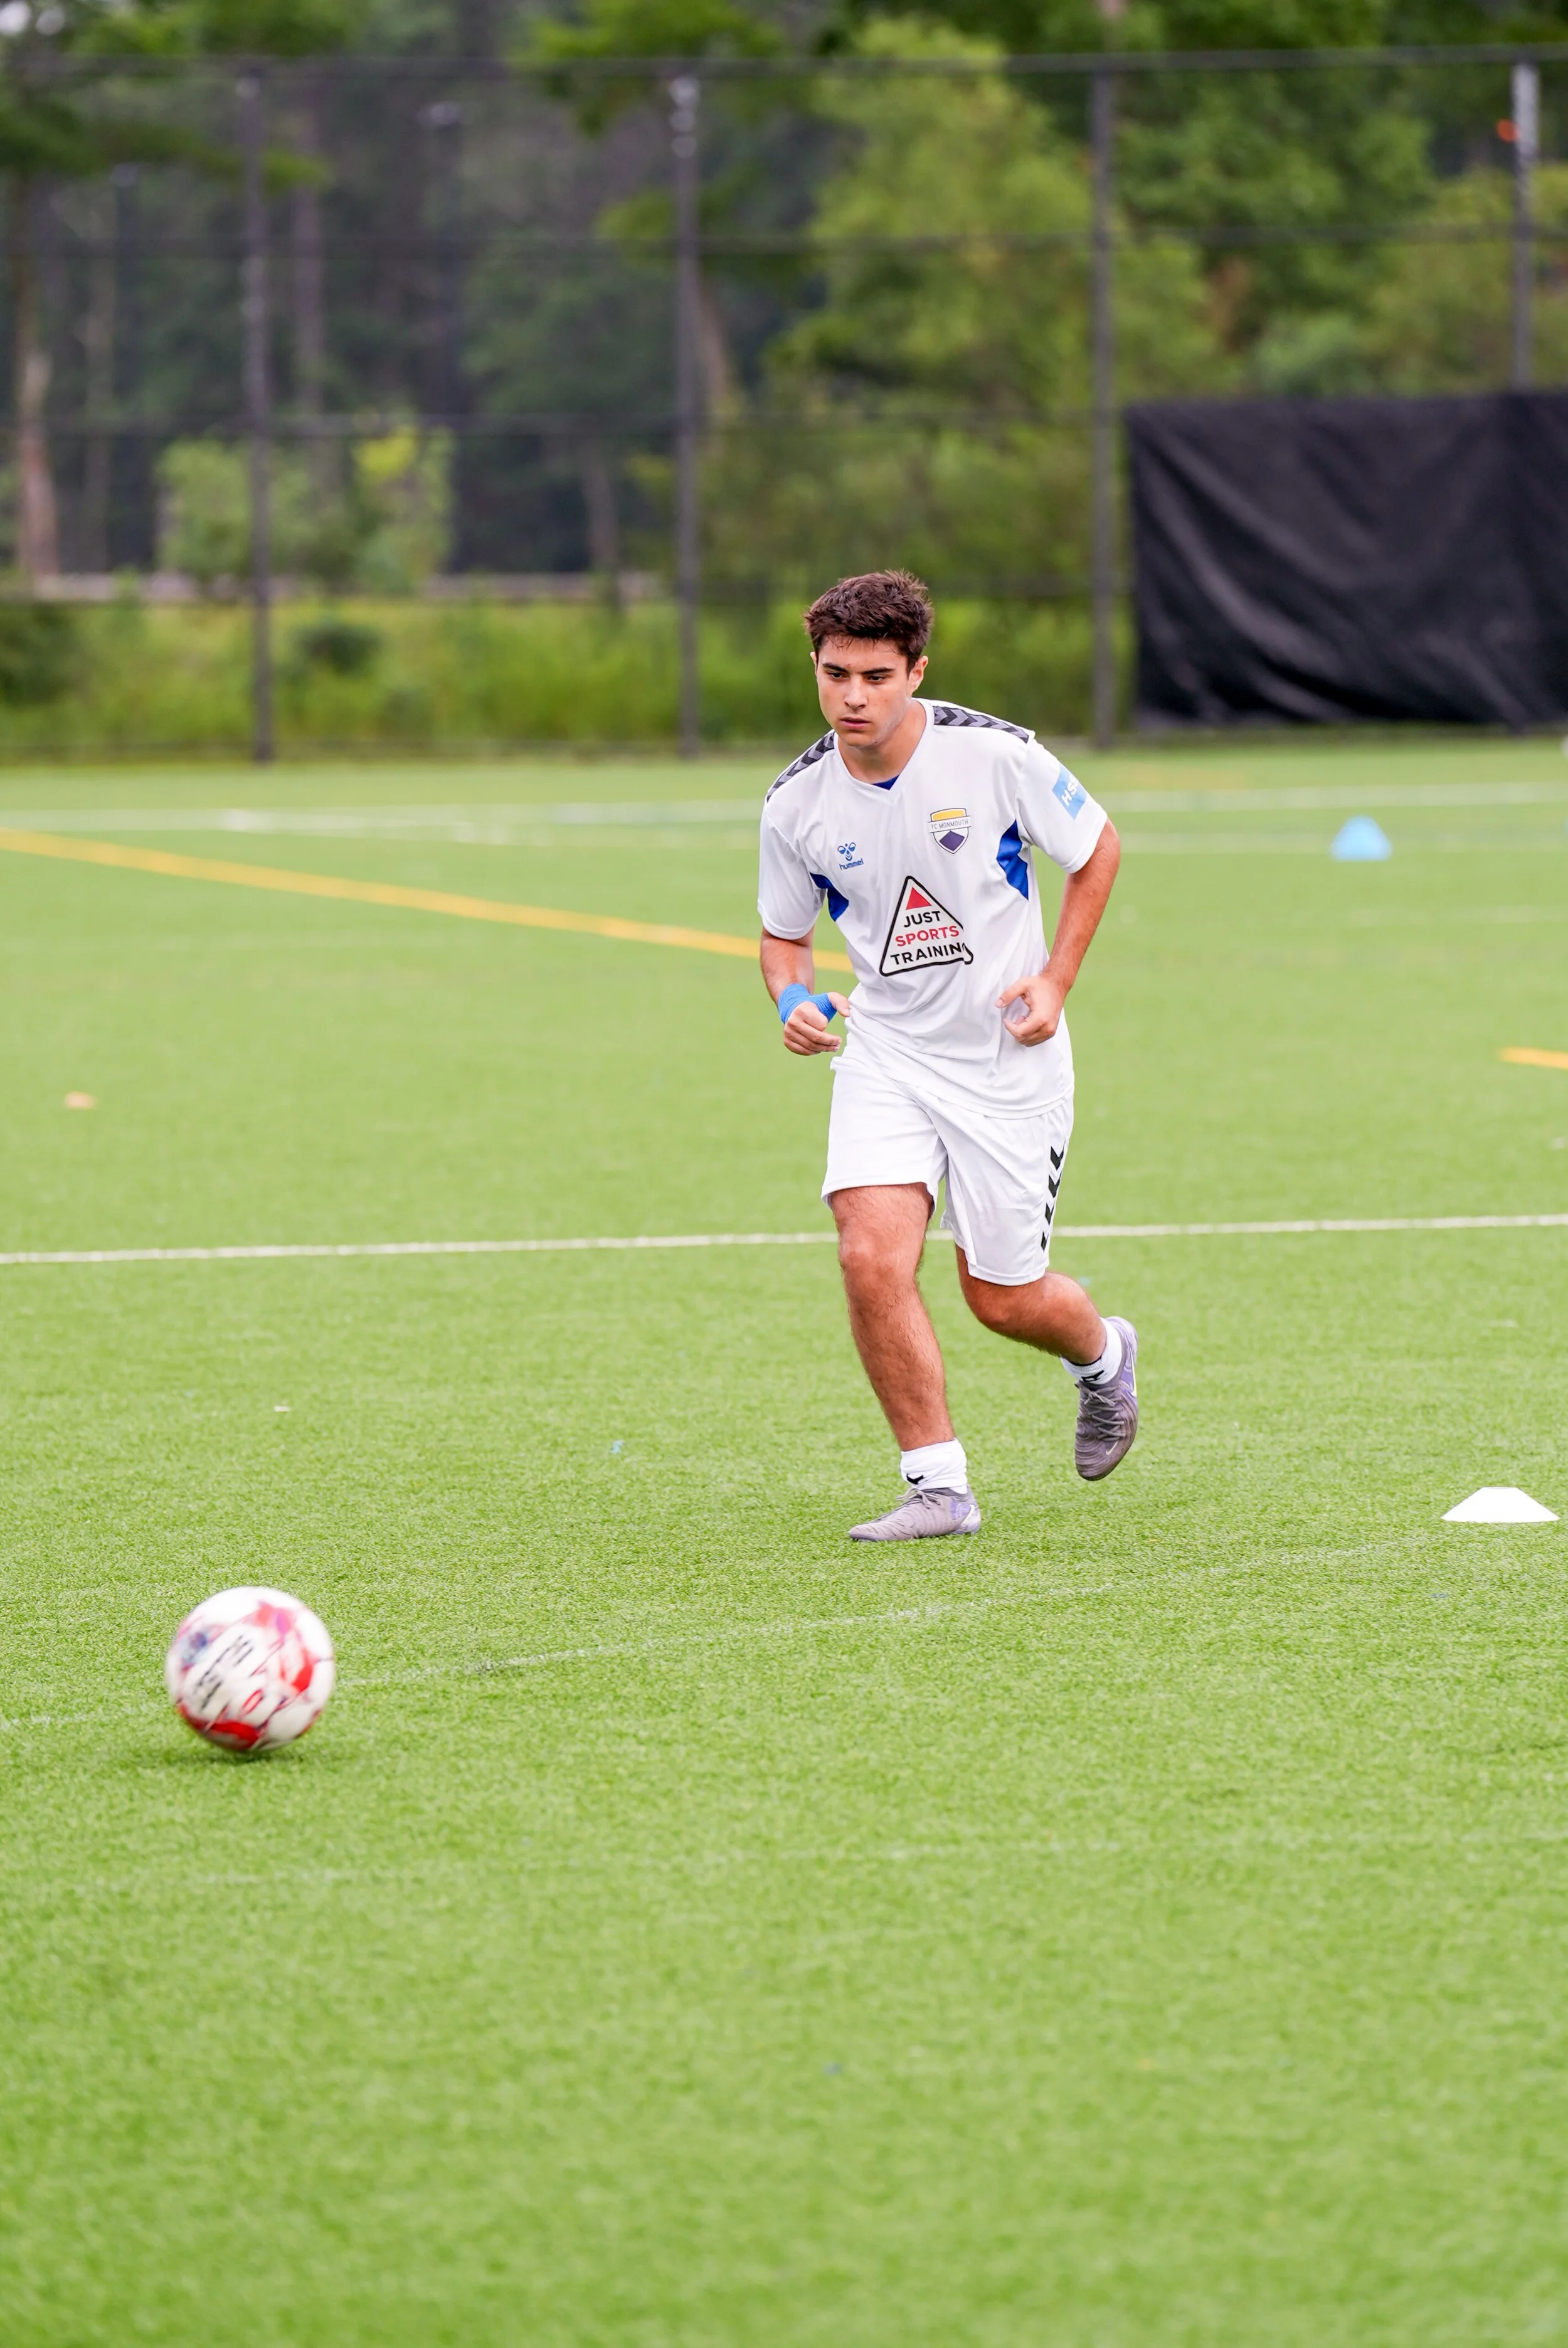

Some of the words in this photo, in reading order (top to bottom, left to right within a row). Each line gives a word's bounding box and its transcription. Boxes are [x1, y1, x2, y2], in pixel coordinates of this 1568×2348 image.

[939, 819, 969, 828] MONMOUTH
[839, 858, 864, 870] hummel
[904, 911, 941, 928] JUST
[895, 925, 959, 947] SPORTS
[890, 942, 966, 965] TRAININ
